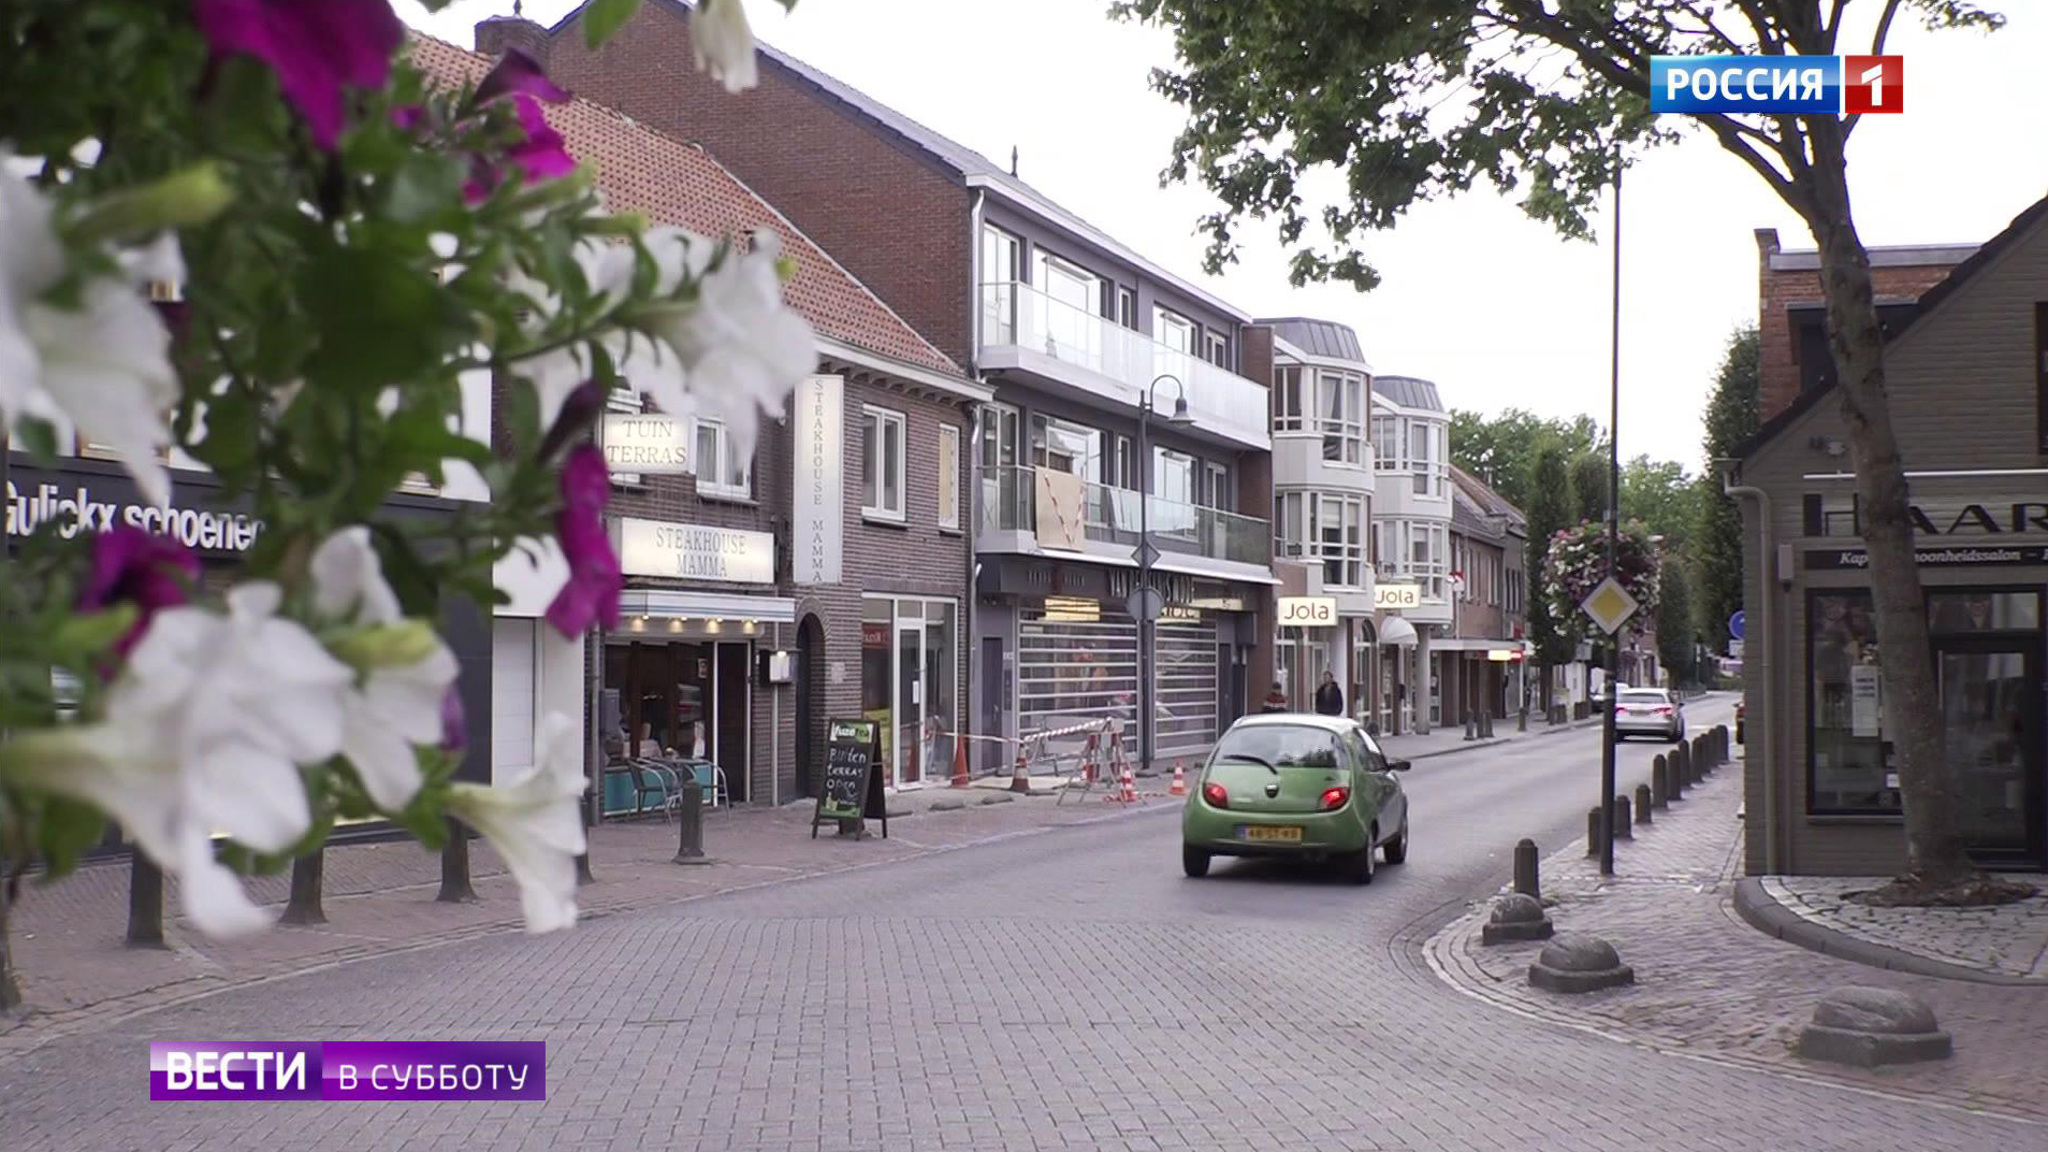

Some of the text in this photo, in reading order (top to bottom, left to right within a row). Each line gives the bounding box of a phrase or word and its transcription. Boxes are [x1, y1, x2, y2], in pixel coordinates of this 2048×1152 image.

[622, 420, 673, 438] TUIN
[606, 444, 687, 464] TERRAS
[812, 378, 824, 582] STEAKHOUSE MAMMA
[656, 526, 747, 555] STEAKHOUSE
[676, 553, 728, 578] MAMMA
[1376, 589, 1414, 604] Jola
[1284, 602, 1329, 620] Jola
